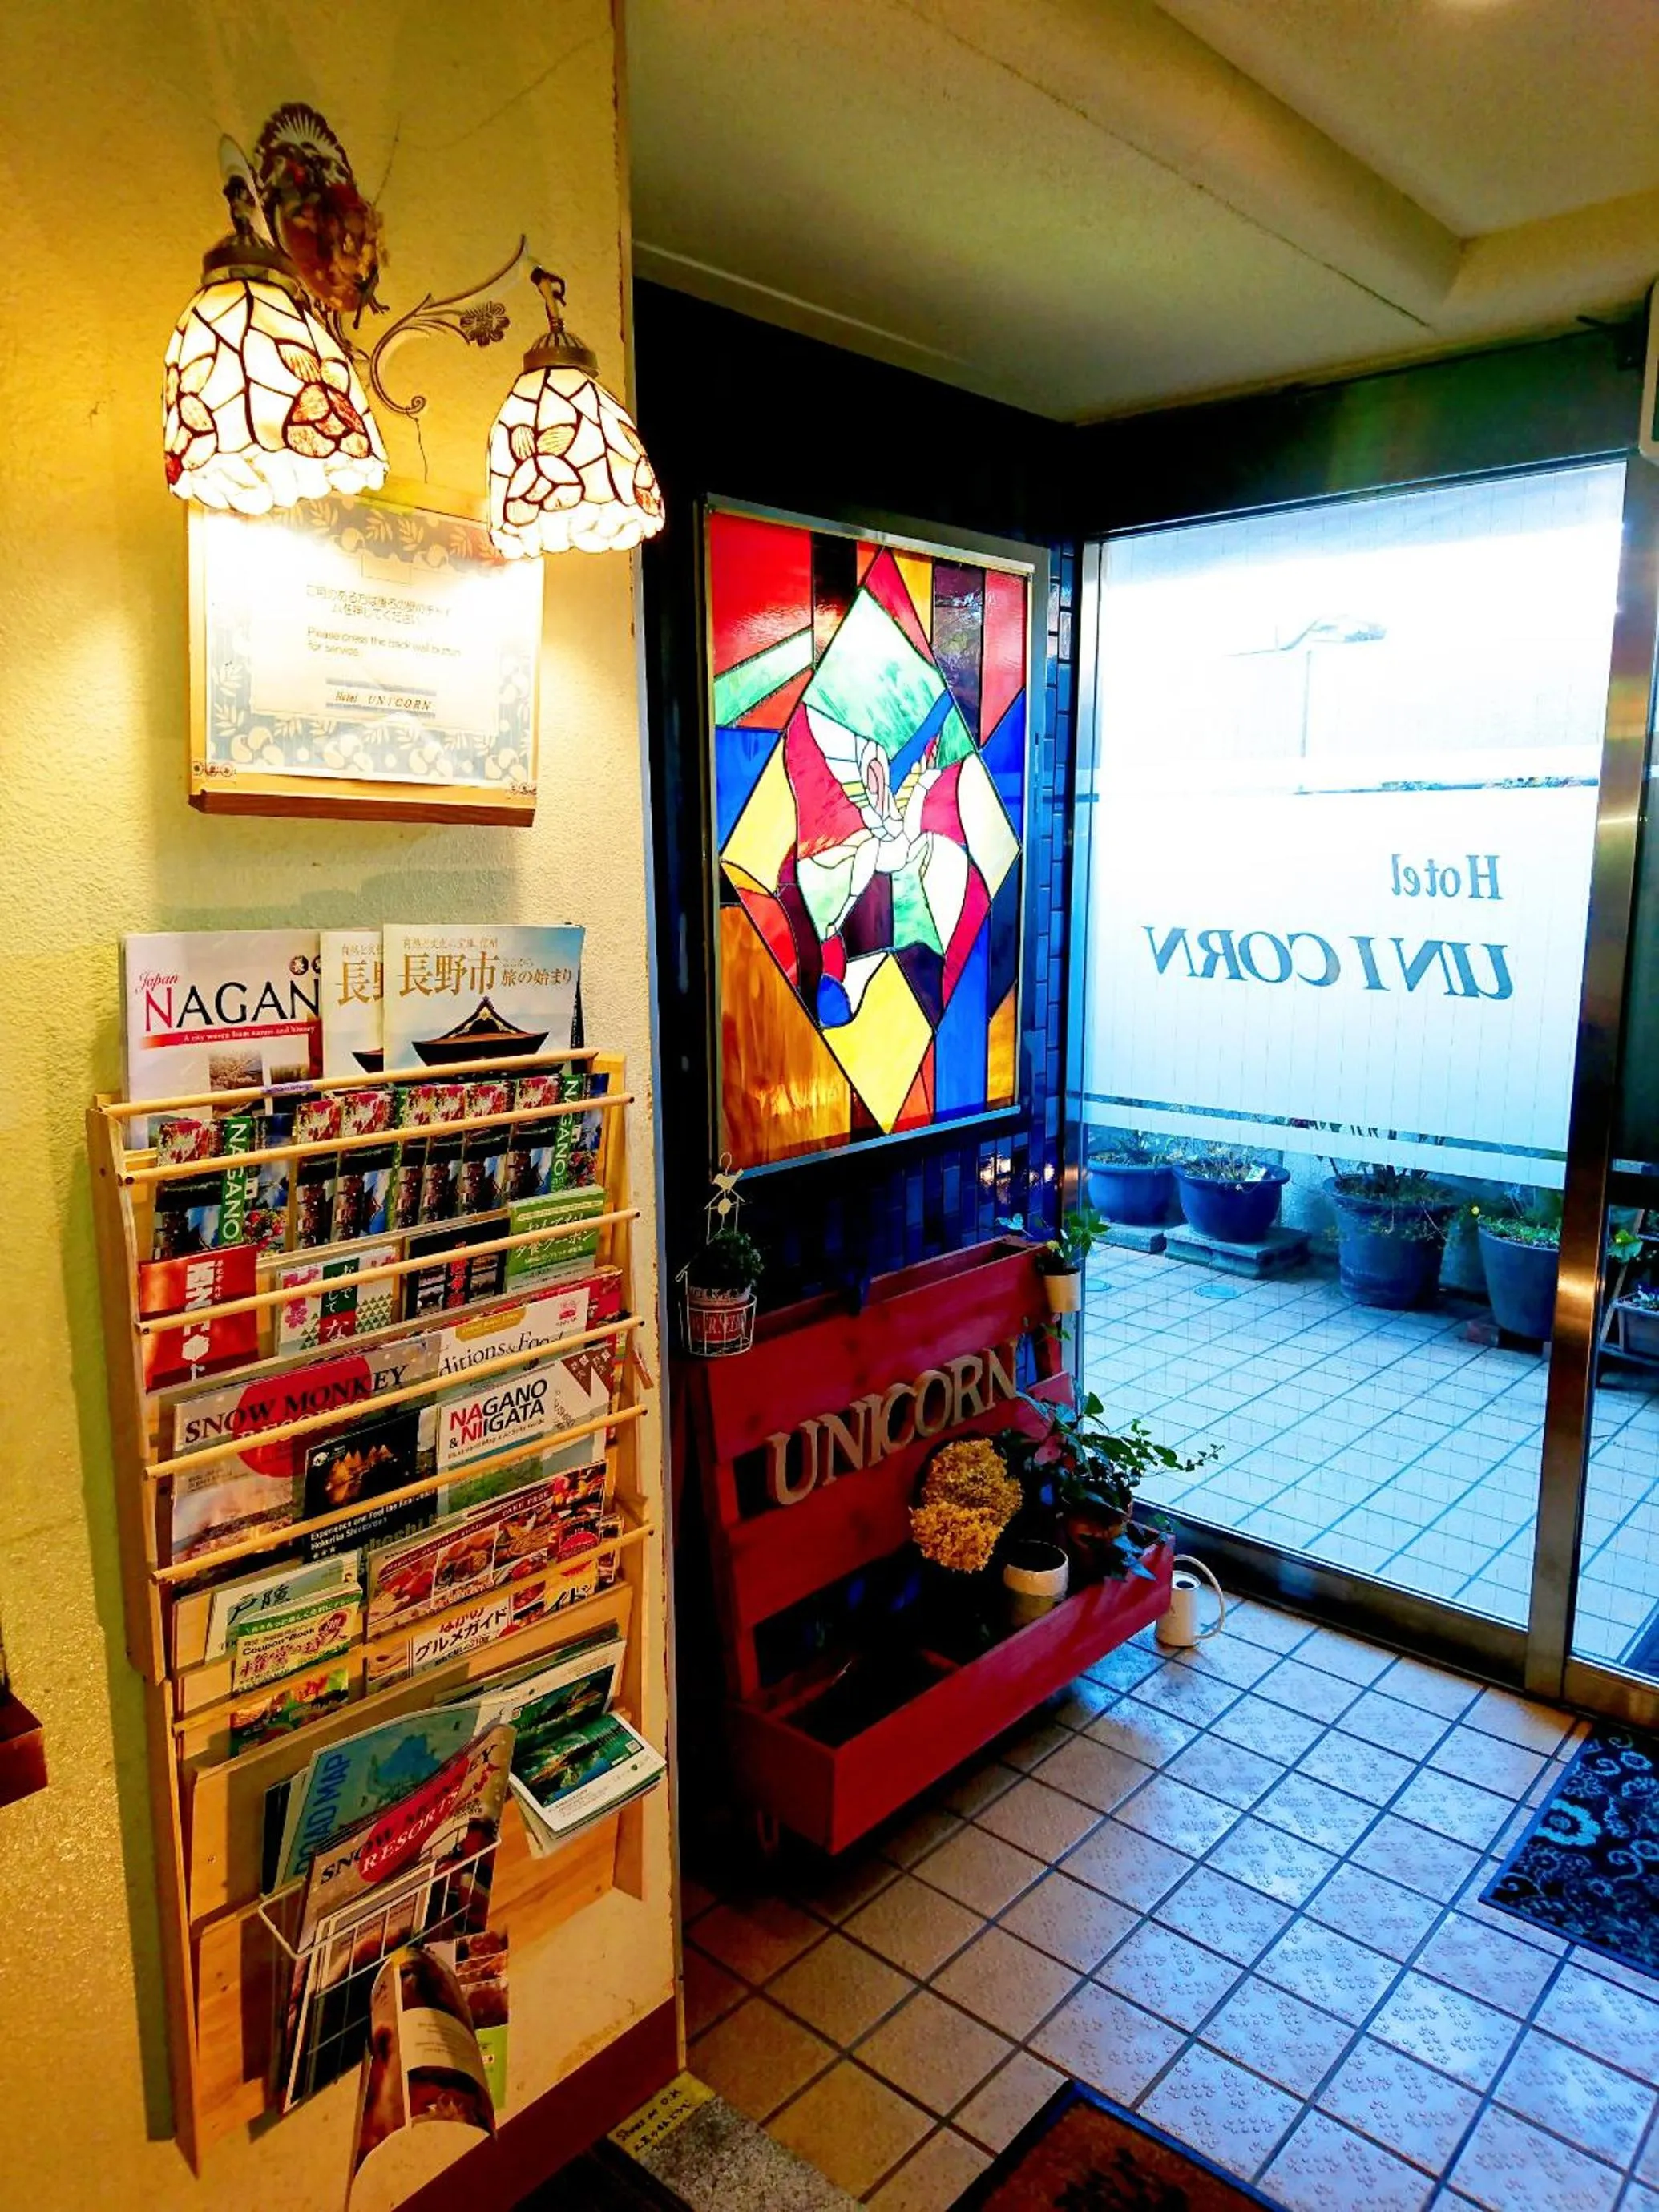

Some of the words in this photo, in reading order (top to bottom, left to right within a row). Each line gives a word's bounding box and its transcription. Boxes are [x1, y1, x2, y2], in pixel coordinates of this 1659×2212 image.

[308, 626, 340, 640] Please
[370, 636, 387, 647] the
[308, 640, 321, 652] for
[335, 691, 358, 704] Hotel
[368, 695, 431, 711] UNICORN
[135, 973, 178, 994] Japan
[336, 959, 383, 1006] 長
[398, 951, 499, 997] 長野市
[501, 968, 571, 987] 旅の始まり
[184, 1034, 190, 1042] A
[276, 1026, 289, 1035] and
[184, 1397, 276, 1443] SNOW
[282, 1365, 408, 1410] MONKEY
[450, 1378, 547, 1431] NAGANO
[449, 1437, 458, 1449] &
[461, 1399, 545, 1446] NIIGATA
[766, 1339, 1018, 1505] UNICORN
[310, 1520, 352, 1541] Experience
[415, 1607, 508, 1663] グルメガイド
[243, 1638, 285, 1656] Coupon
